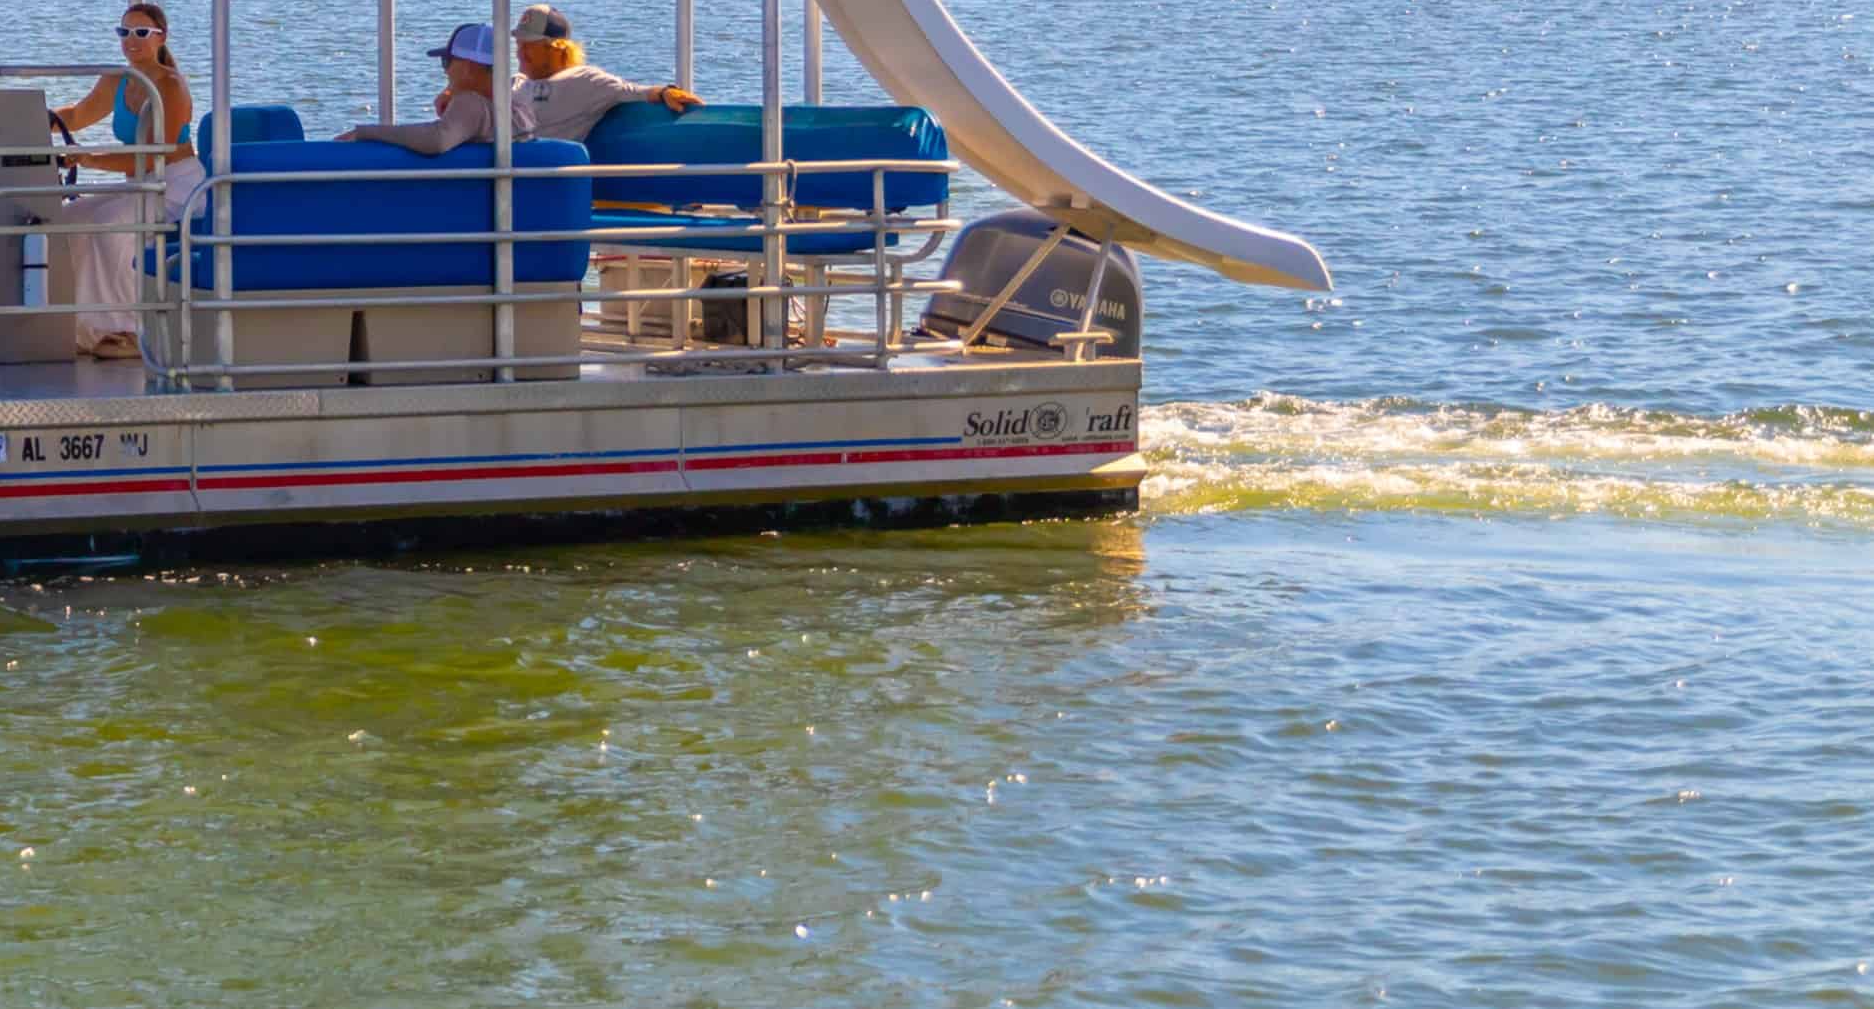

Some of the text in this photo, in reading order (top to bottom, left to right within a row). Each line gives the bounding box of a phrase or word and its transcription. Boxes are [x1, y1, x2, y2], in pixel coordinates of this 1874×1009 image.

[1070, 294, 1125, 320] YAAHA
[964, 404, 1133, 437] Solid raft
[22, 437, 46, 461] AL
[60, 435, 104, 460] 3667
